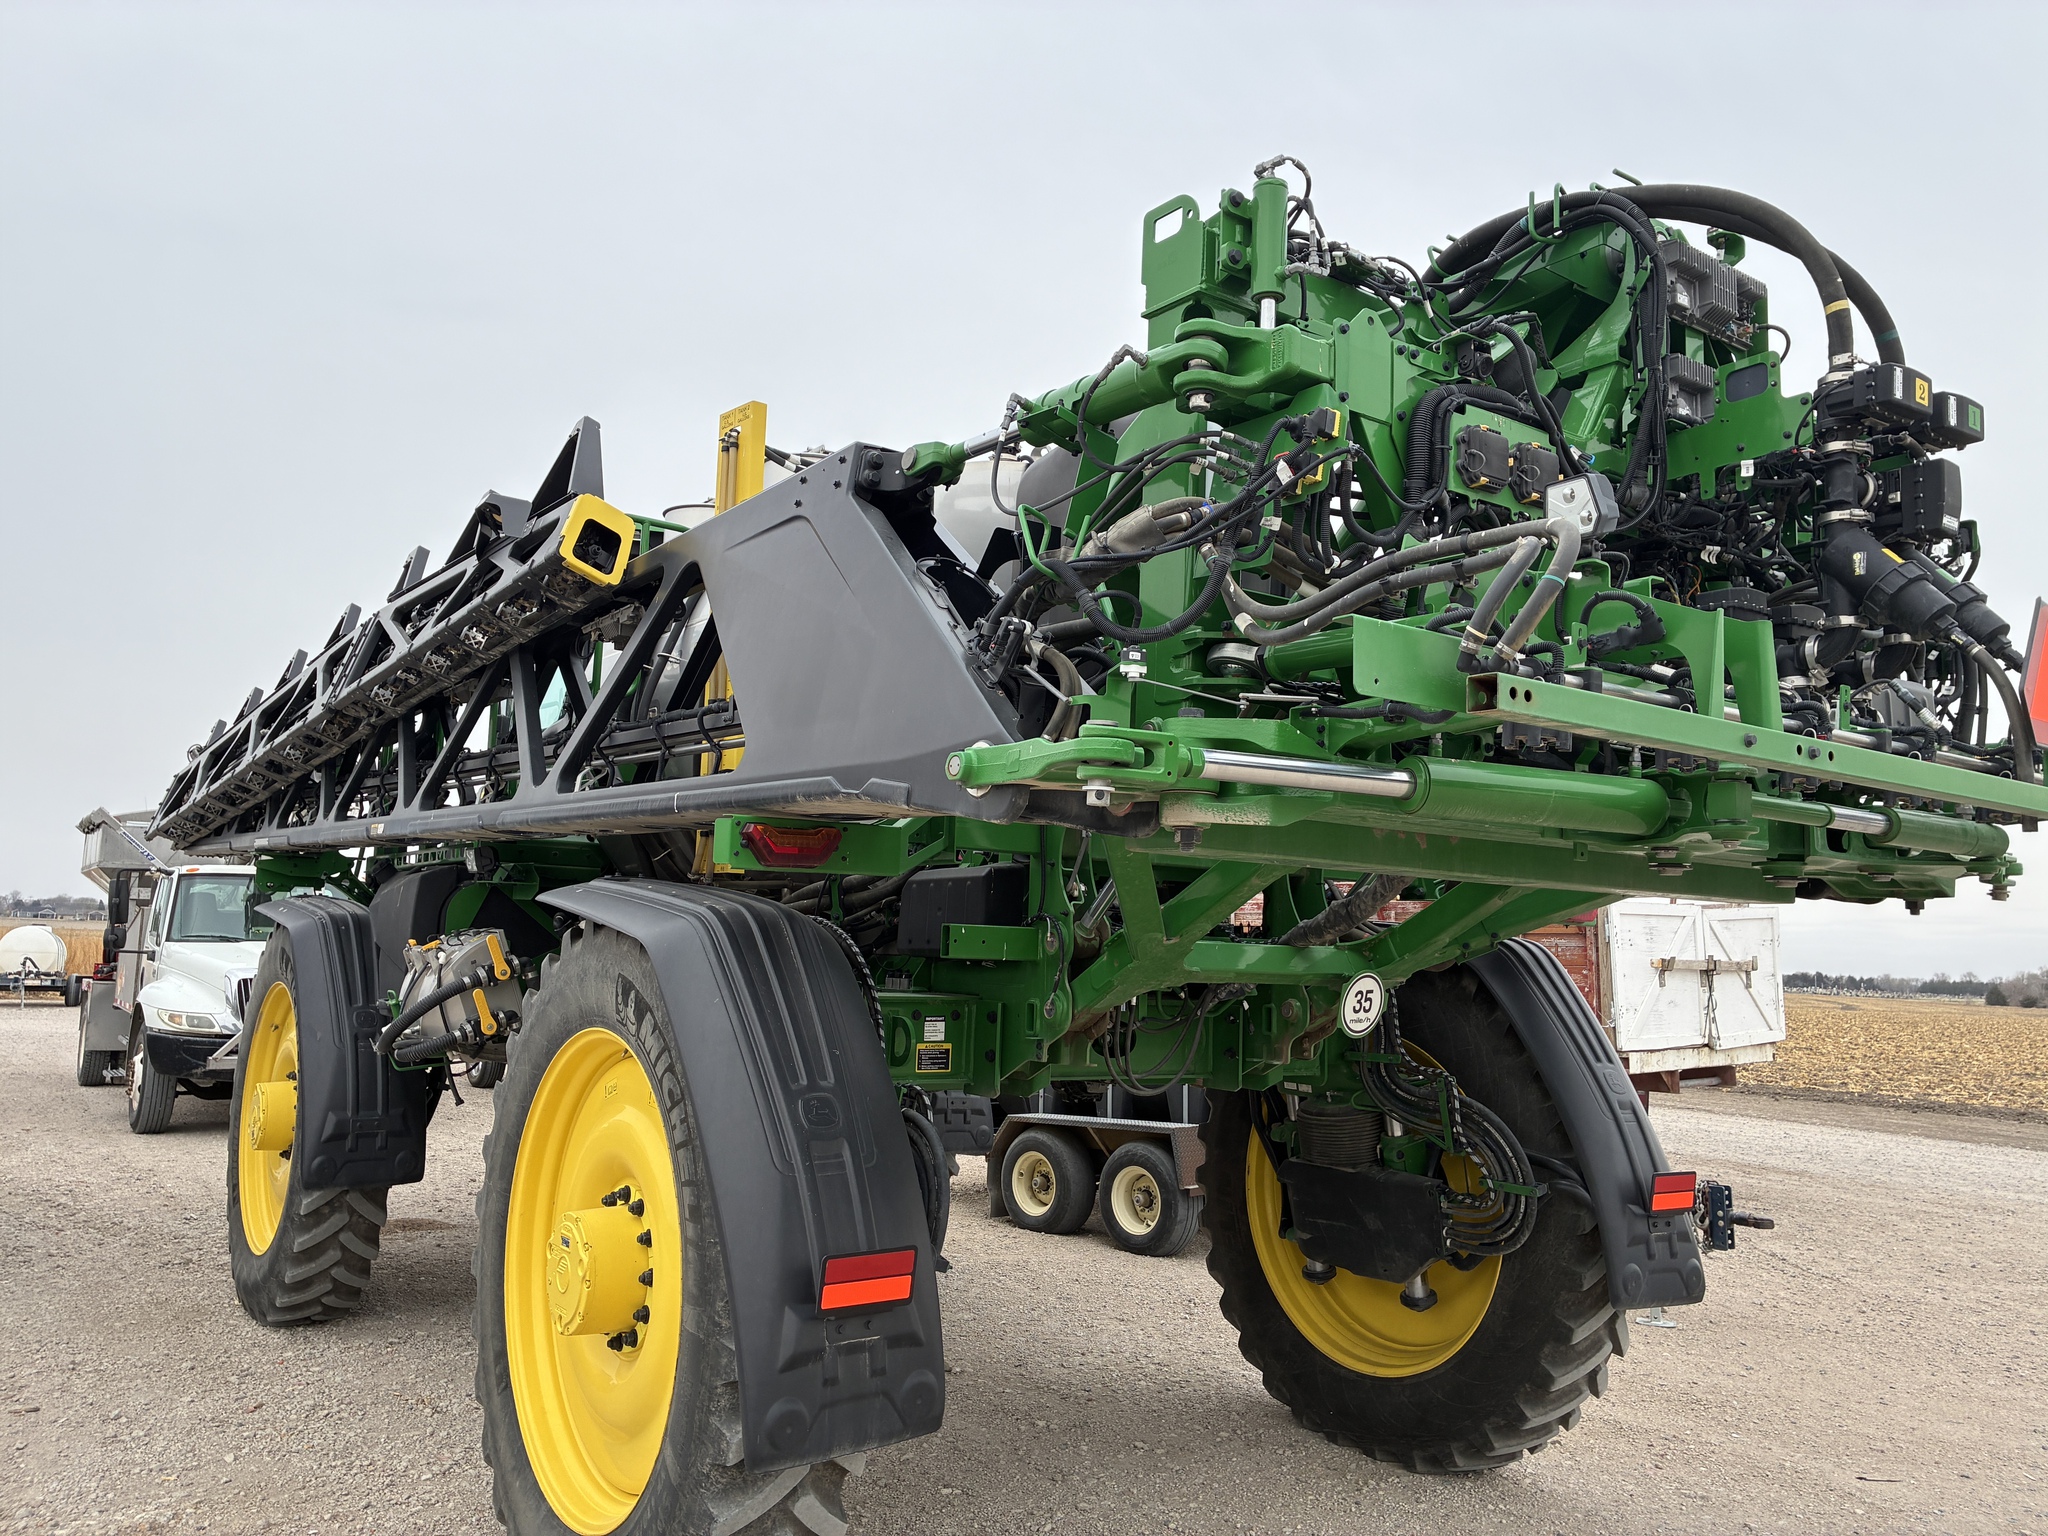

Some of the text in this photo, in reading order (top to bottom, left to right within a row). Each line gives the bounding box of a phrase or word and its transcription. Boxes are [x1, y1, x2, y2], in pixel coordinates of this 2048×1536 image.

[1919, 383, 1926, 401] 2
[1972, 410, 1977, 426] 1
[1352, 989, 1374, 1014] 35
[1349, 1016, 1371, 1024] mile/h
